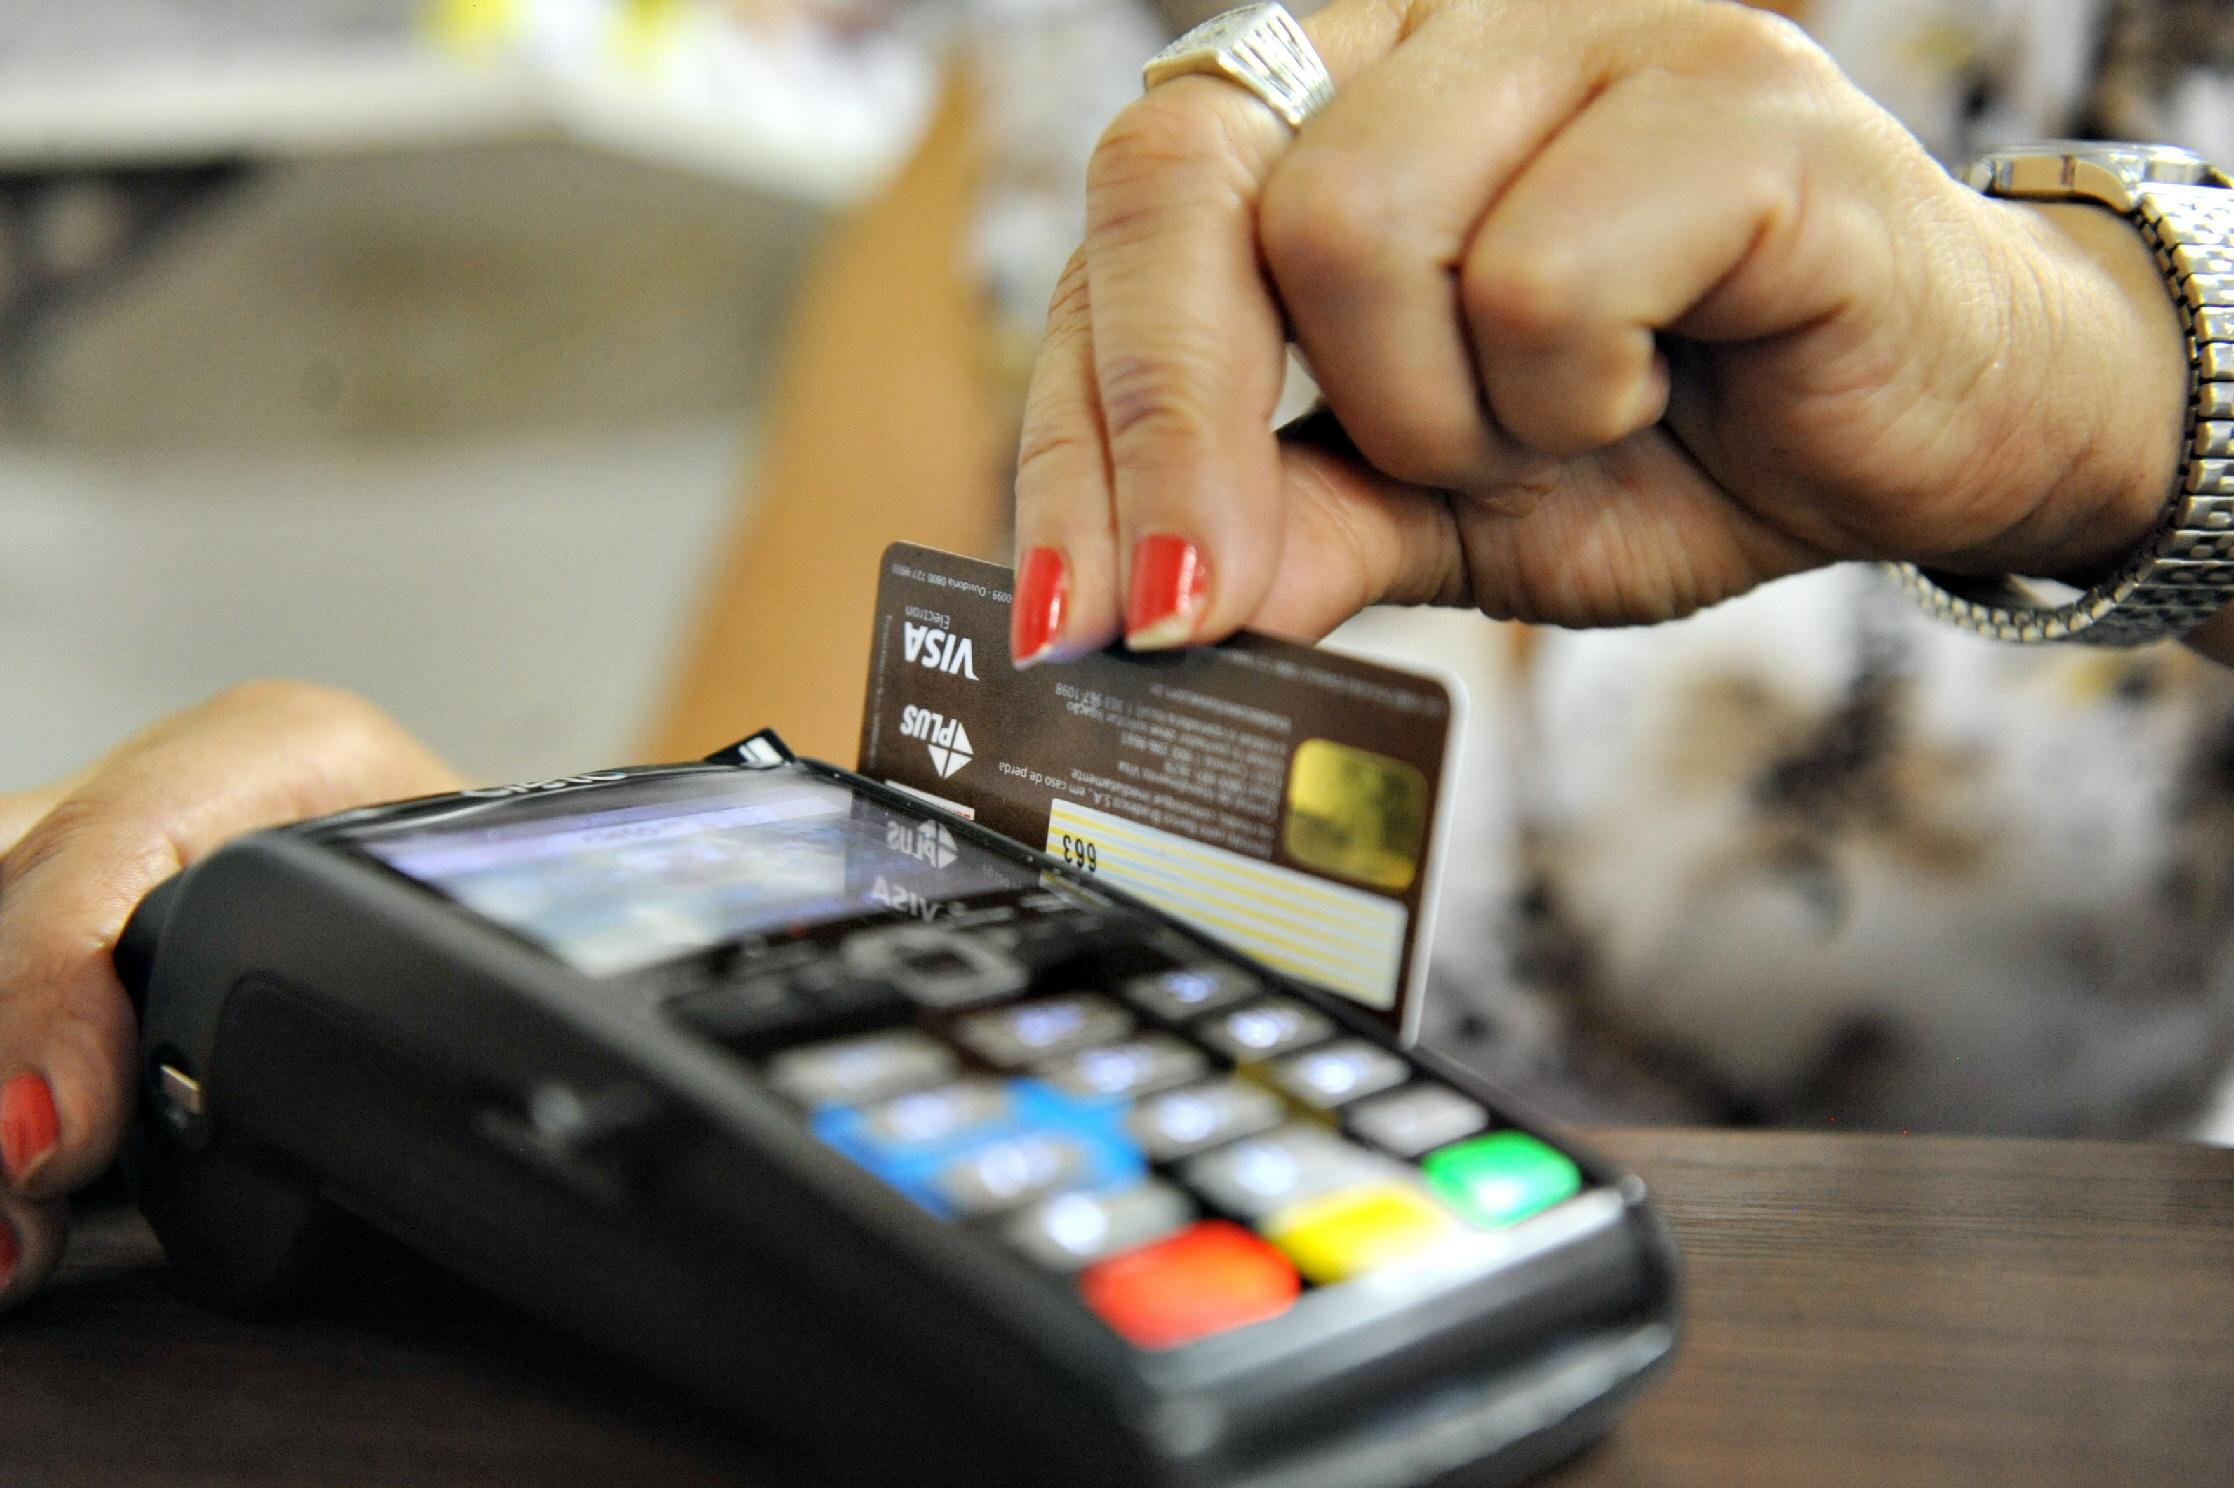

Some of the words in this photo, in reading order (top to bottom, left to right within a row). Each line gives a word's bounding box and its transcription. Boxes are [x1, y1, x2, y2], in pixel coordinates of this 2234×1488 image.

[948, 577, 986, 596] Ouvidoria
[905, 606, 950, 629] Electron
[903, 622, 979, 681] VISA
[900, 704, 956, 744] PLUS
[998, 761, 1028, 778] perda
[1029, 770, 1043, 786] de
[1044, 775, 1066, 792] caso
[1069, 784, 1086, 798] em
[1062, 835, 1097, 872] 663
